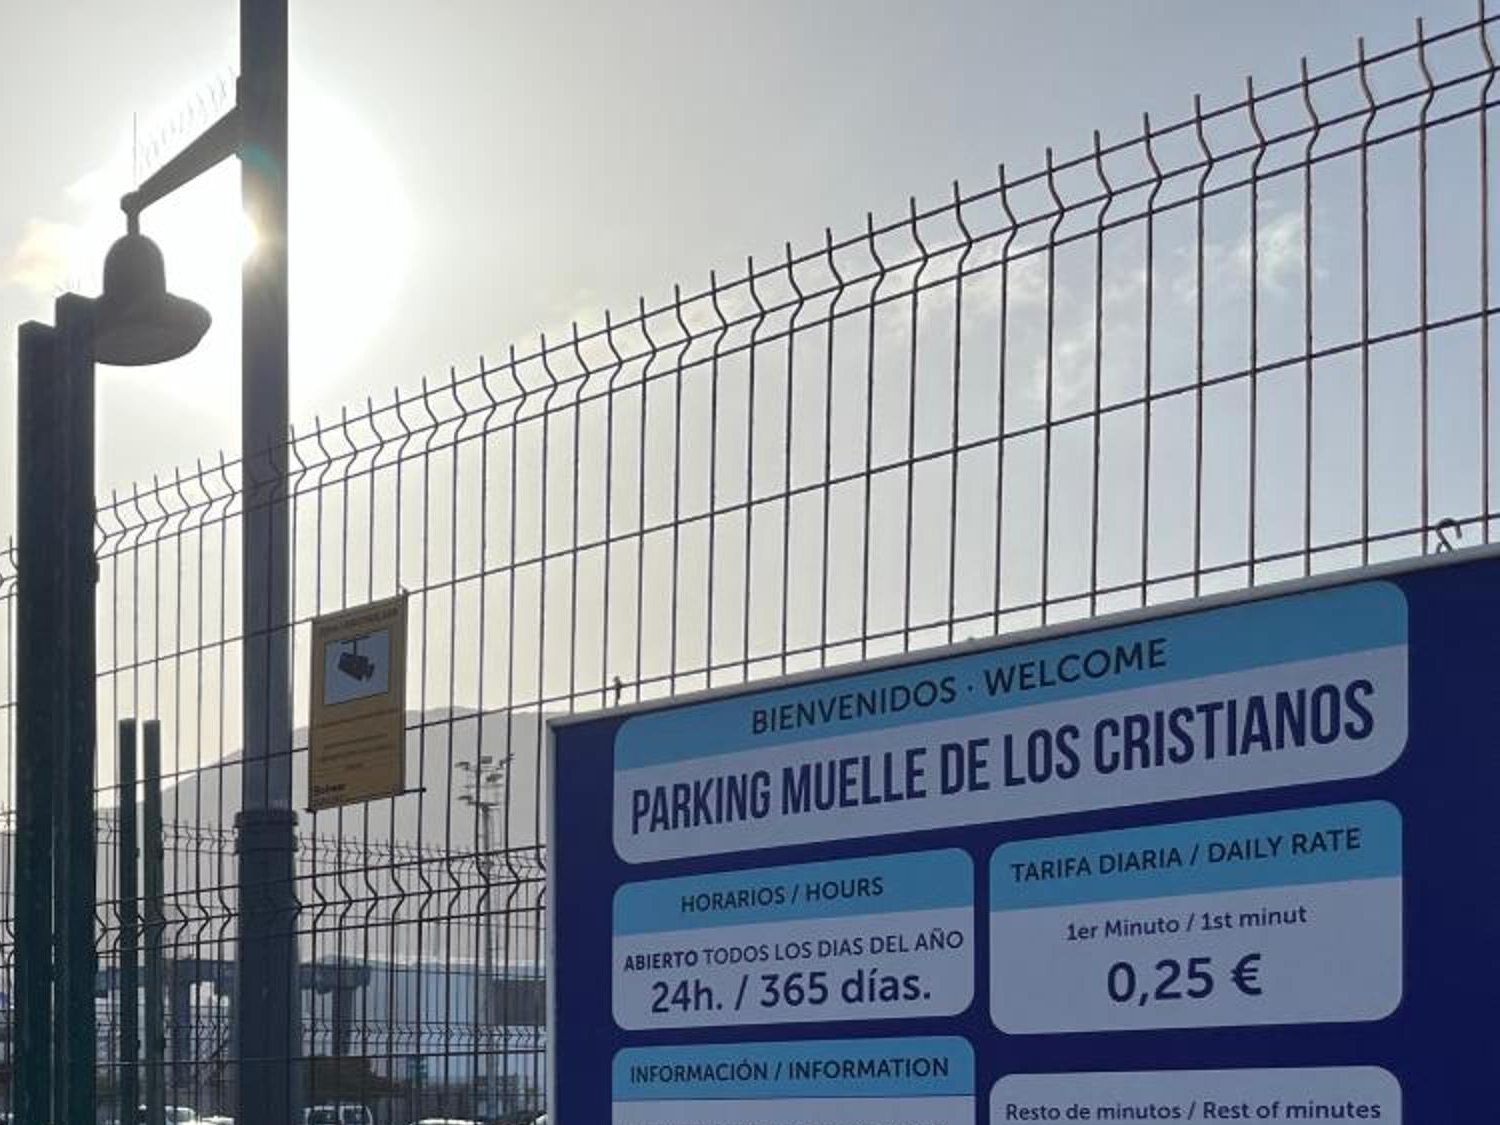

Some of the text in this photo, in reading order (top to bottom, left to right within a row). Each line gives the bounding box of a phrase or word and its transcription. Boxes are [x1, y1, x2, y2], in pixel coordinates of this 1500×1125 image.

[752, 638, 1167, 735] BIENVENIDOS WELCOME
[632, 680, 1374, 834] PARKING MUELLE DE LOS CRISTIANOS
[1011, 853, 1092, 884] TARIFA
[1100, 846, 1184, 875] DIARIA
[1208, 835, 1284, 866] DAILY
[1292, 827, 1360, 858] RATE
[681, 885, 786, 914] HORARIOS
[806, 876, 884, 904] HOURS
[1066, 921, 1098, 940] 1er
[1104, 912, 1179, 938] Minuto
[1202, 908, 1232, 930] 1st
[1238, 904, 1306, 928] minut
[624, 927, 964, 971] ABIERTO TODOS LOS DIAS DEL AÑO
[651, 975, 724, 1014] 24h.
[760, 974, 828, 1008] 365
[842, 964, 932, 1004] días.
[1107, 952, 1263, 1010] 0,25 €
[630, 1059, 768, 1084] INFORMACIÓN
[789, 1057, 948, 1079] INFORMATION
[1005, 1103, 1060, 1120] Resto
[1066, 1104, 1090, 1120] de
[1097, 1102, 1181, 1120] minutos
[1203, 1101, 1250, 1119] Rest
[1257, 1101, 1280, 1118] of
[1286, 1102, 1380, 1119] minutes
